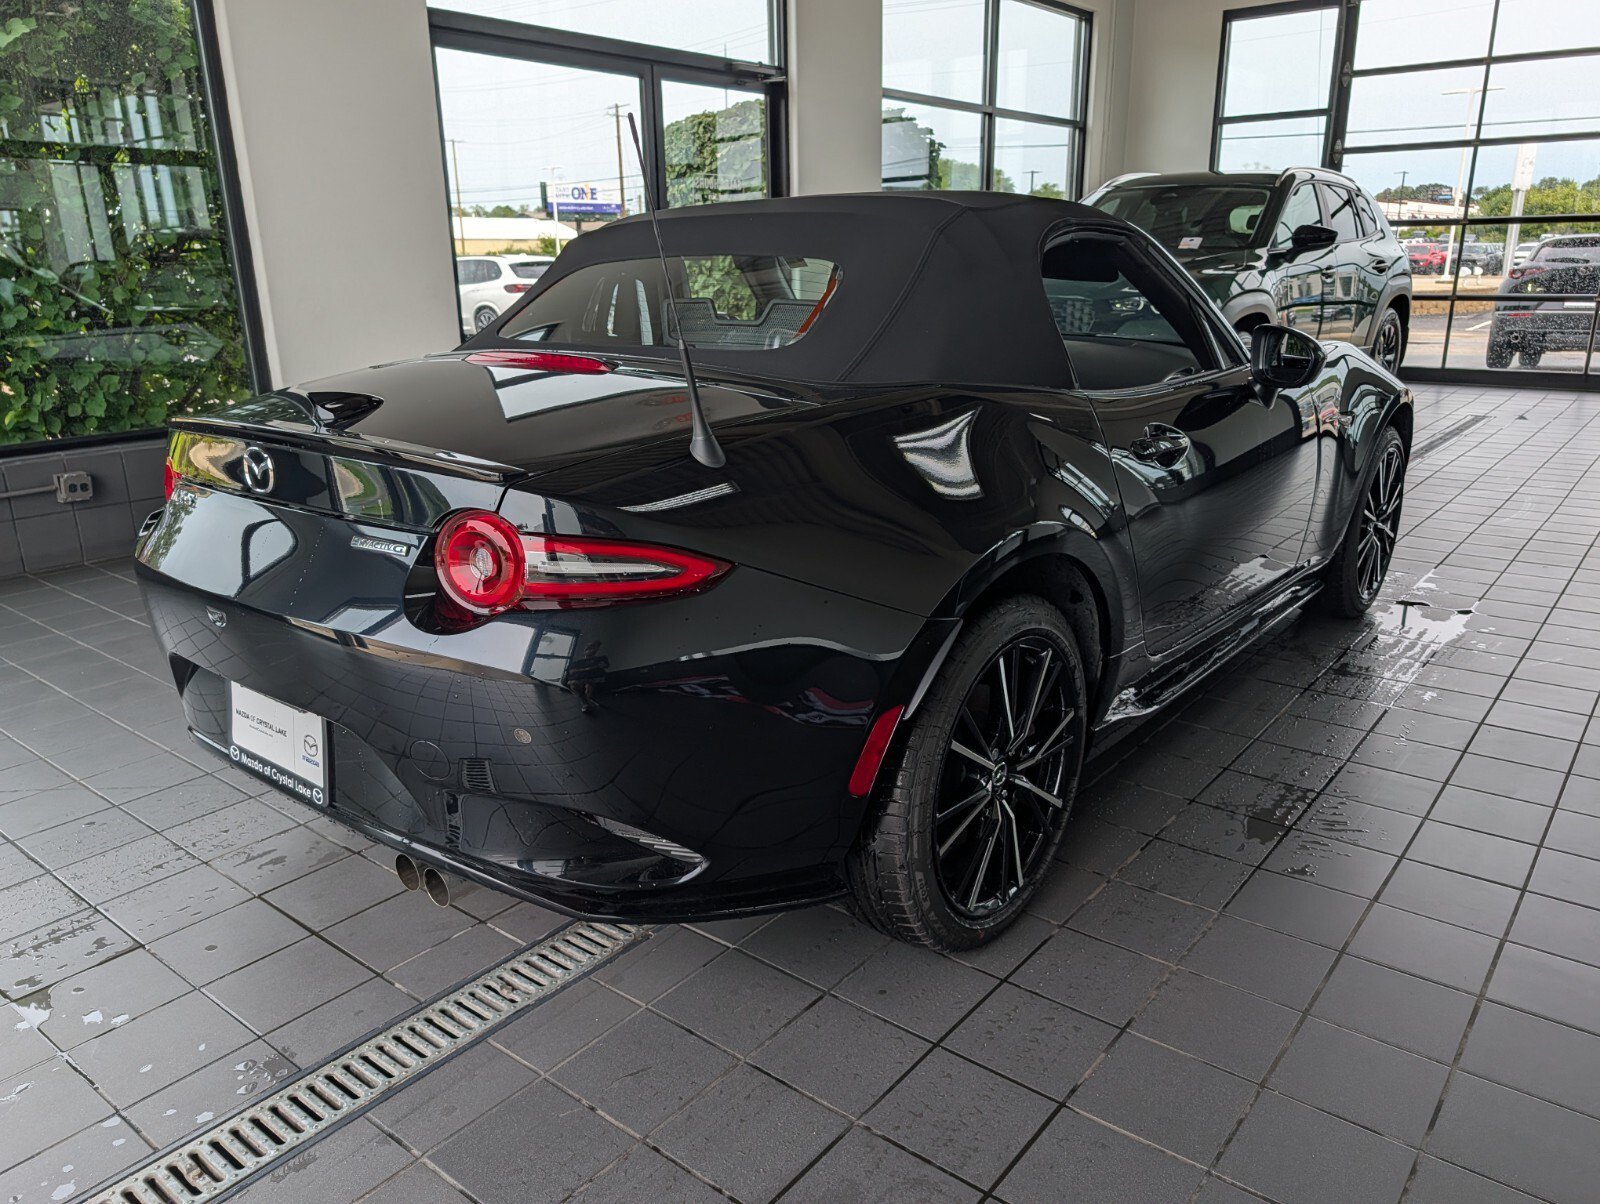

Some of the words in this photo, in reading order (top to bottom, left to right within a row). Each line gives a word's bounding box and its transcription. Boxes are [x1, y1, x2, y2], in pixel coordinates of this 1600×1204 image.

[571, 186, 598, 200] ONE
[235, 708, 250, 720] MAZDA
[256, 717, 275, 732] CRYSTAL
[275, 727, 287, 738] LAKE
[241, 752, 263, 772] Mazda
[264, 765, 271, 776] of
[271, 768, 294, 788] Crystal
[295, 781, 311, 797] Lake
